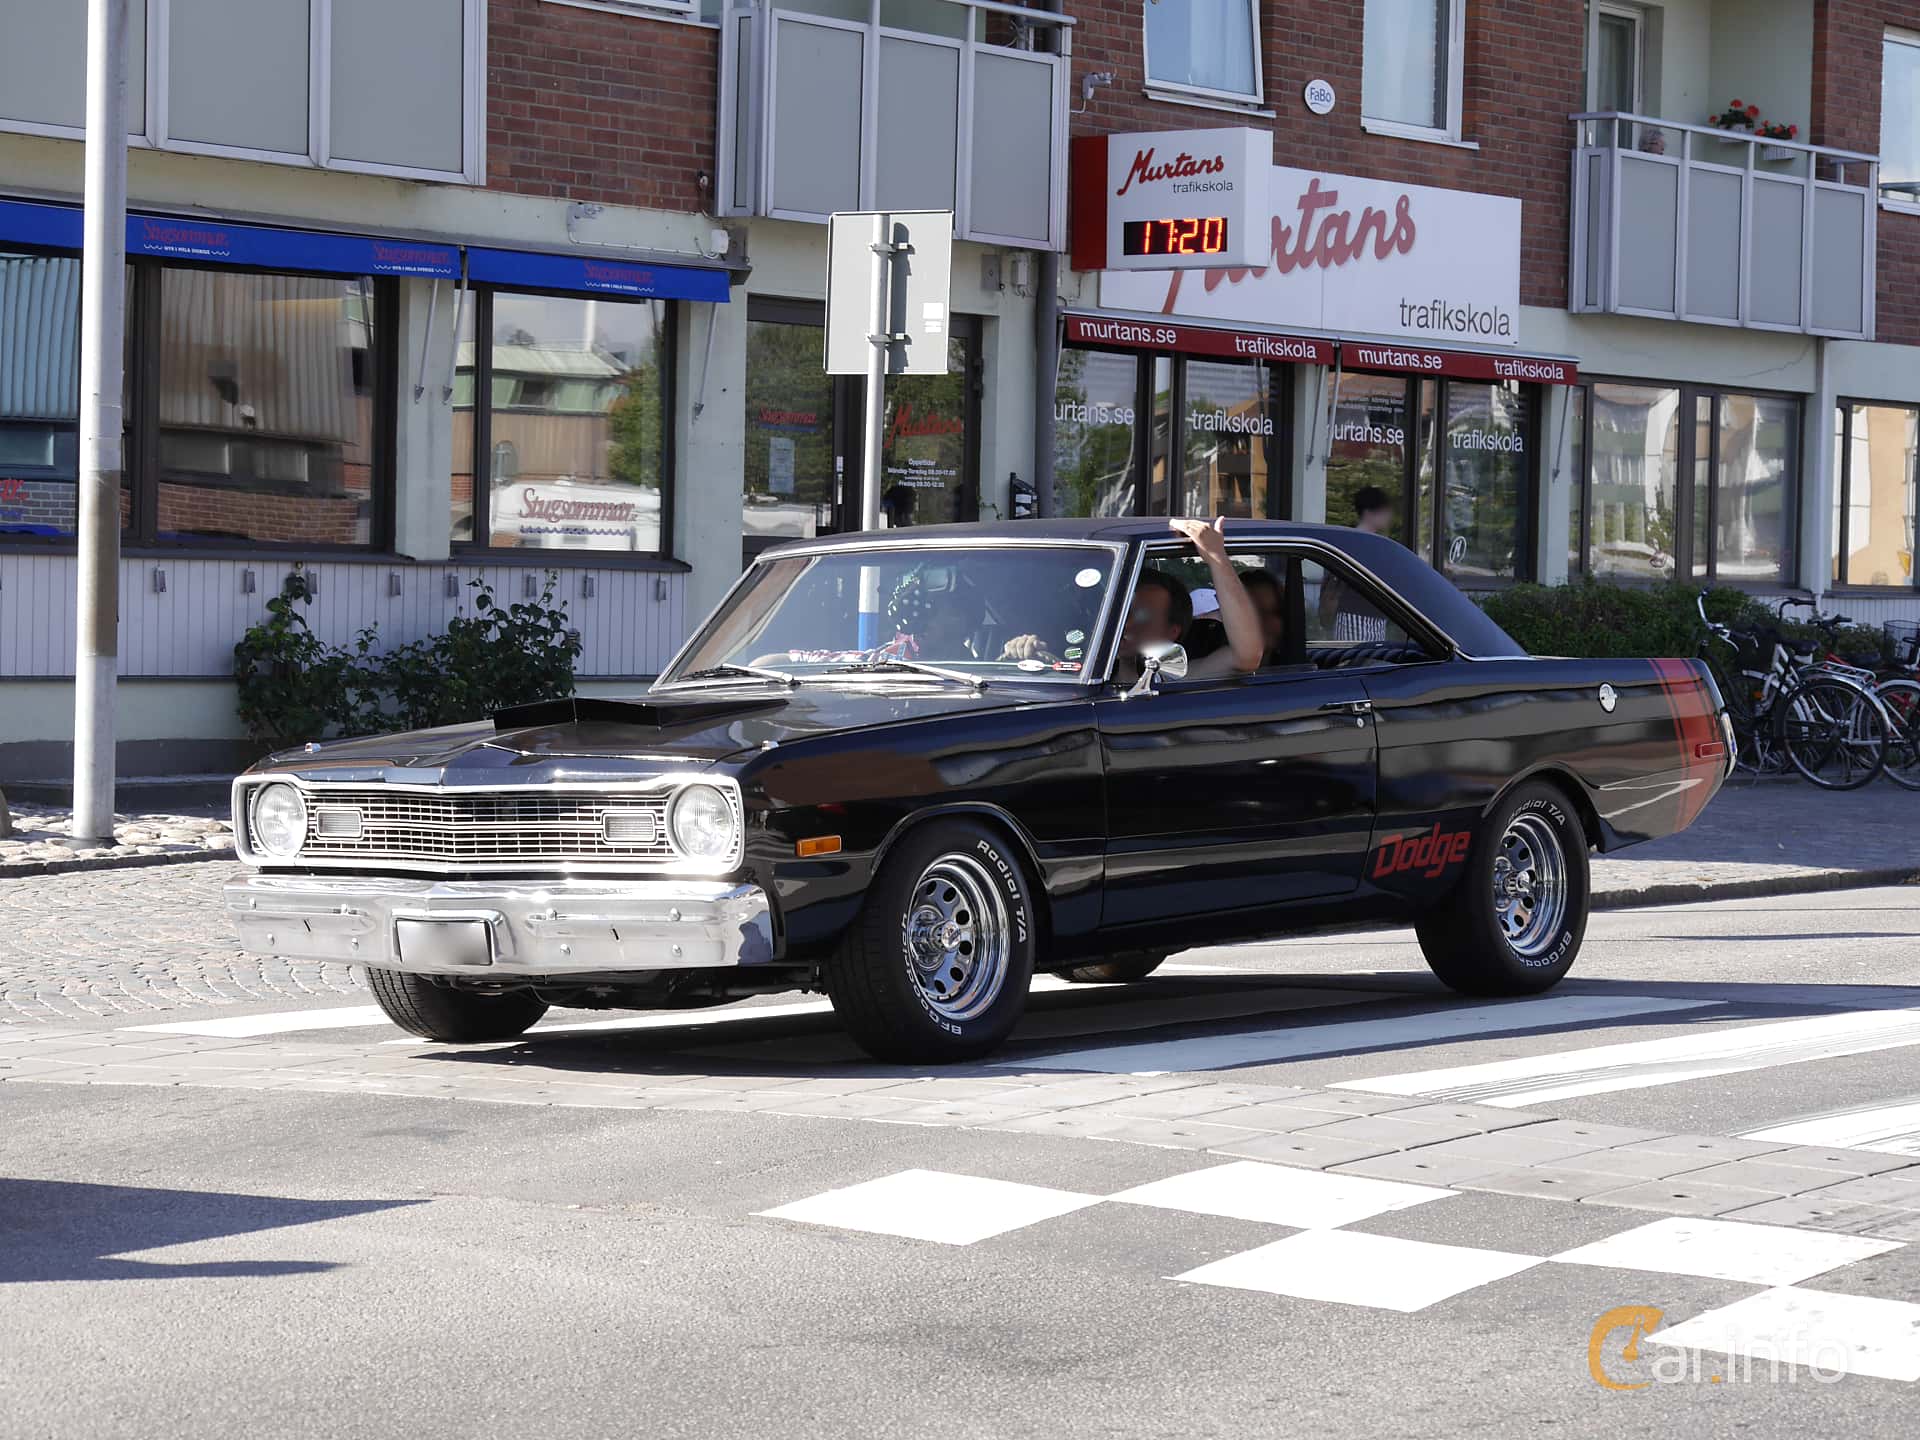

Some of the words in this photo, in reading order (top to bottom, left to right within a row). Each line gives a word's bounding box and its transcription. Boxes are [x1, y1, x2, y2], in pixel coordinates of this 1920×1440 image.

[1310, 87, 1332, 103] FaBo
[1116, 147, 1225, 196] Murtans
[1172, 180, 1234, 194] trafikskola
[1143, 216, 1223, 254] 17:20
[1400, 297, 1511, 336] trafikskola
[1079, 319, 1177, 345] murtans.se
[1235, 335, 1317, 360] trafikskola
[1358, 348, 1443, 370] murtans.se
[1493, 359, 1564, 381] trafikskola
[1054, 401, 1135, 425] urtans.se
[1191, 409, 1274, 436] trafikskola
[1334, 421, 1405, 445] urtans.se
[1452, 429, 1525, 453] trafikskola
[1372, 821, 1472, 879] Dodge
[977, 839, 1021, 900] Radial
[1015, 904, 1028, 943] T/A
